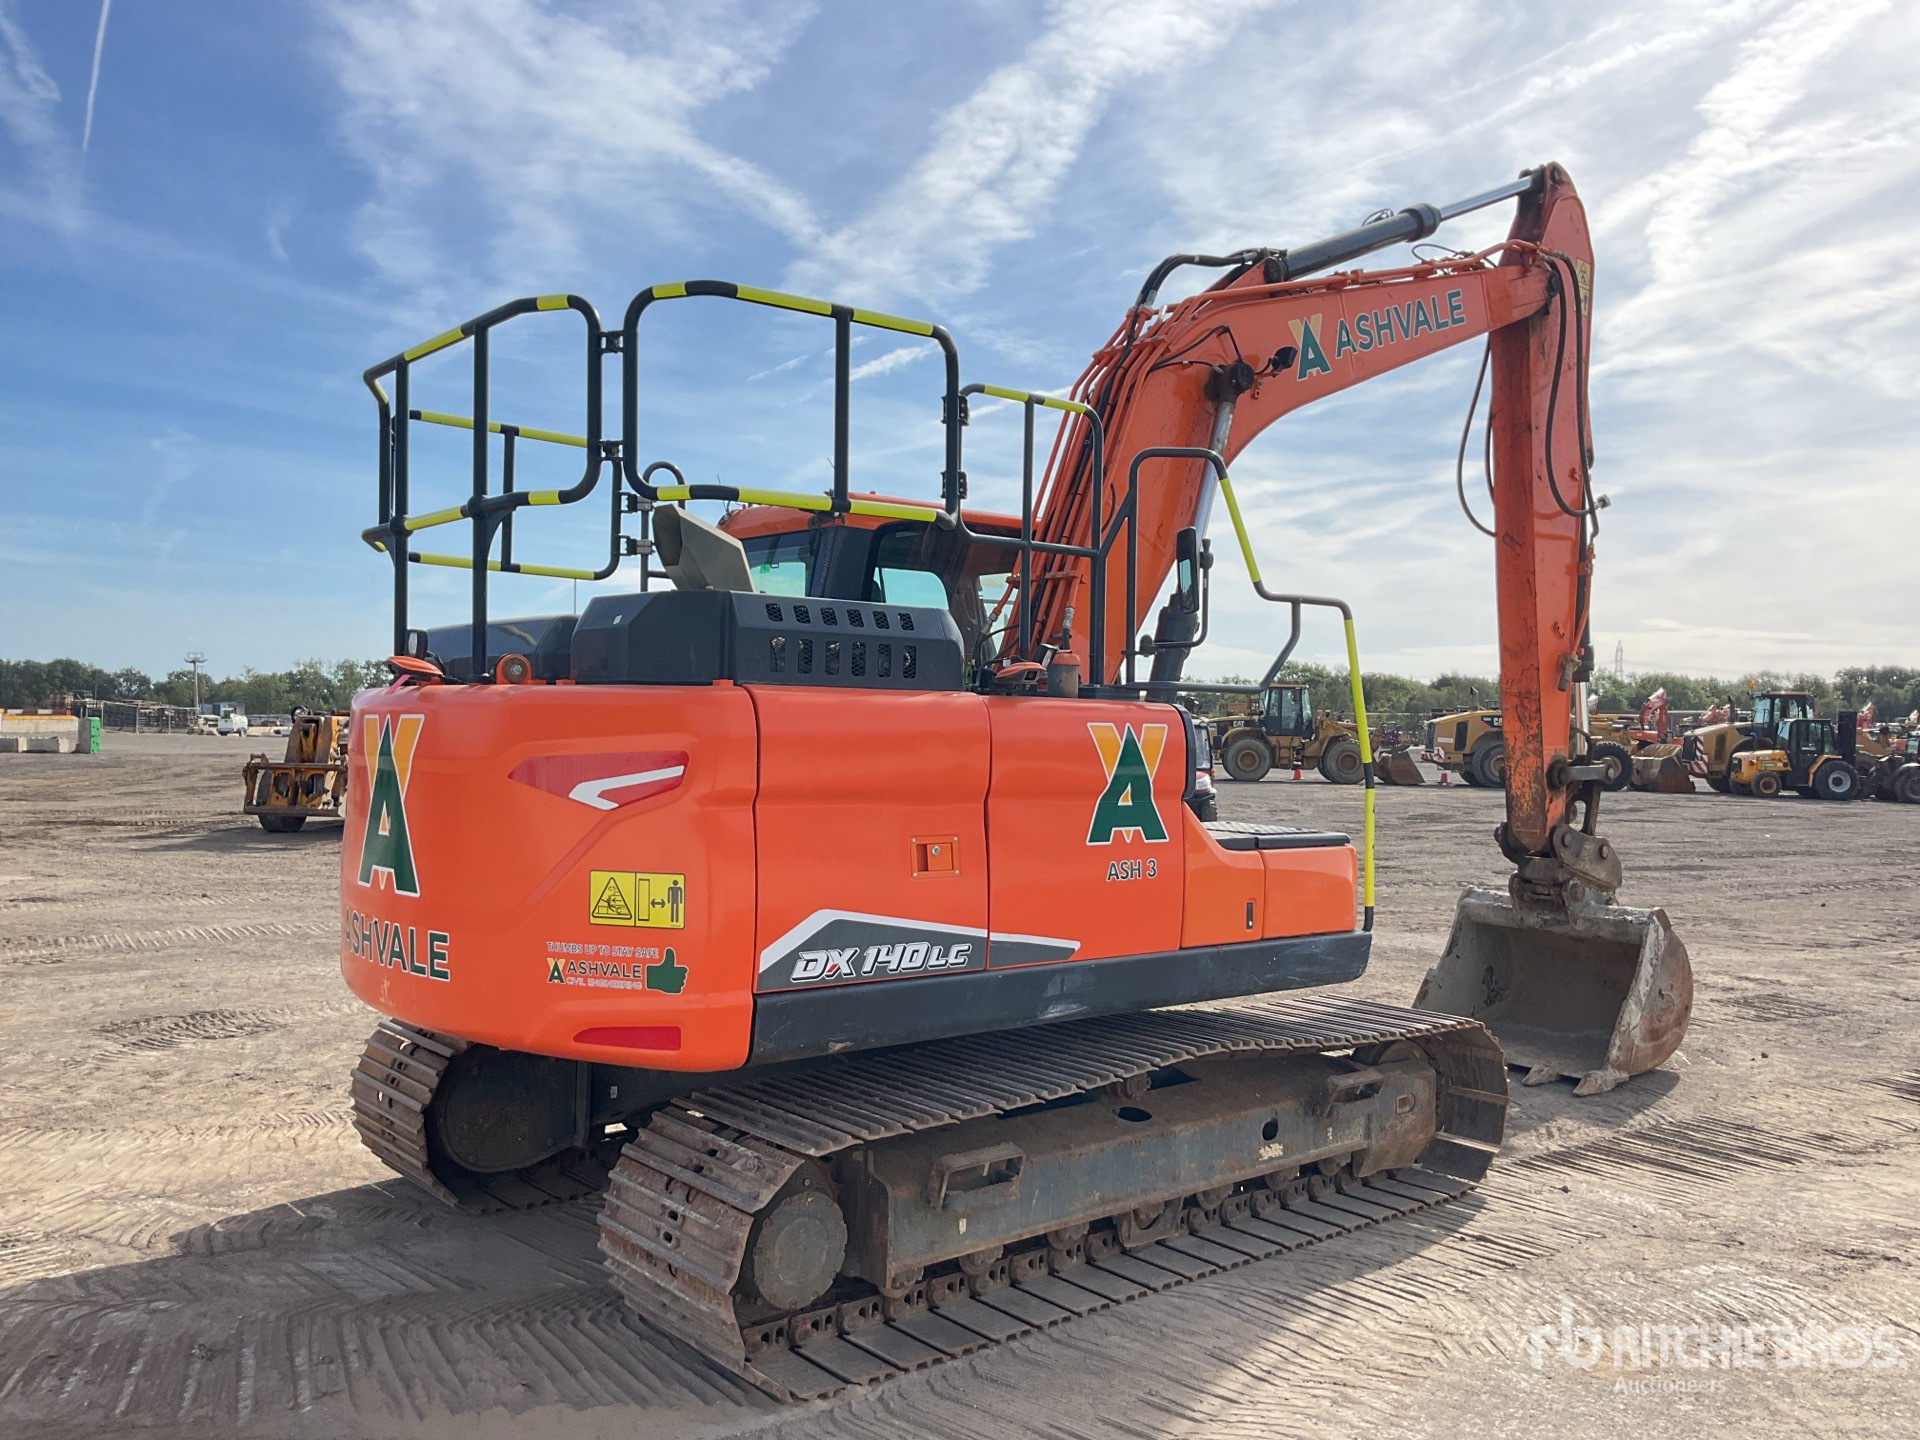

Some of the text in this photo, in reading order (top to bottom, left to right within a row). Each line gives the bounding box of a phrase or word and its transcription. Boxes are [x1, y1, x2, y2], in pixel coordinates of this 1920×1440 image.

[1335, 288, 1467, 358] ASHVALE
[1232, 720, 1245, 728] CAT
[1106, 858, 1157, 881] ASH 3
[344, 905, 450, 982] ASHVALE
[547, 942, 659, 957] THUMBS UP TO STAY SAFE
[567, 960, 641, 978] ASHVALE
[790, 947, 860, 983] DX
[567, 977, 586, 986] CIVIL
